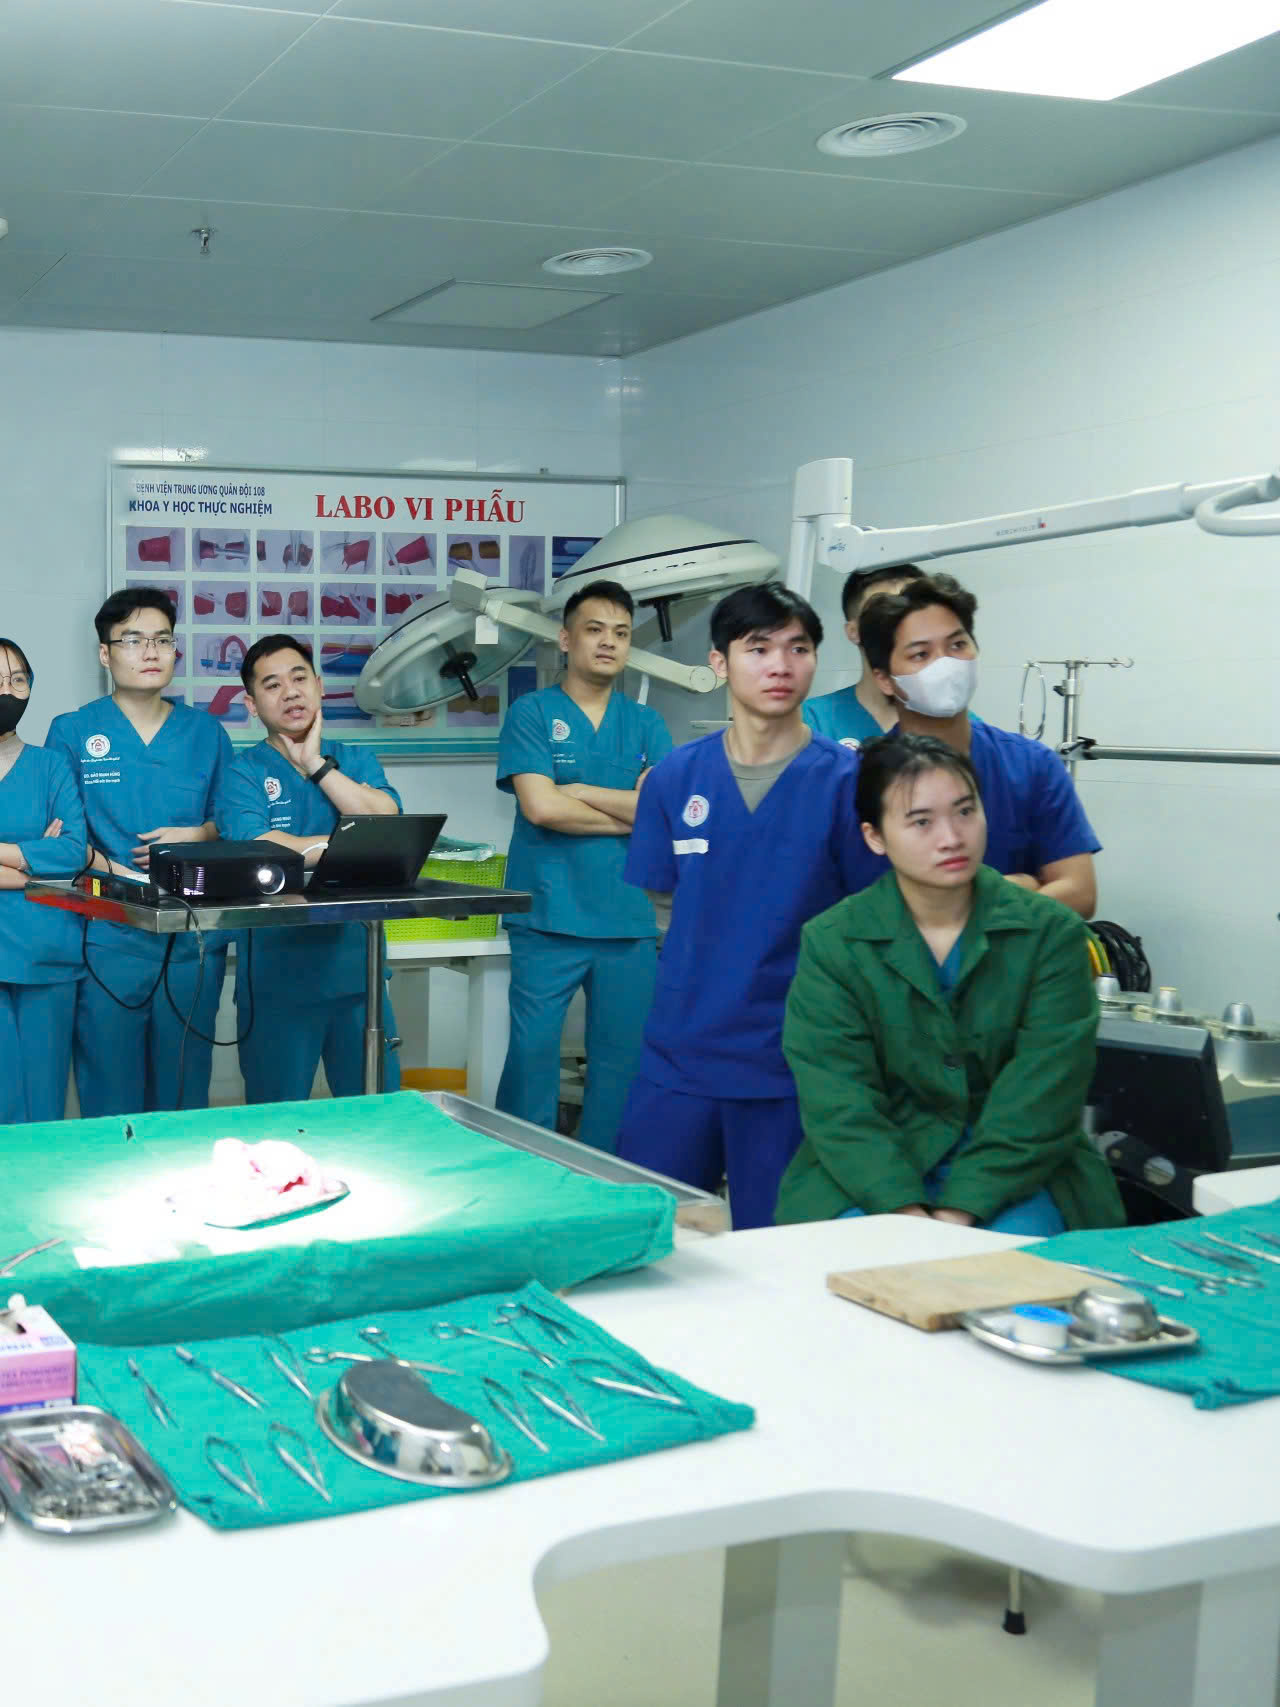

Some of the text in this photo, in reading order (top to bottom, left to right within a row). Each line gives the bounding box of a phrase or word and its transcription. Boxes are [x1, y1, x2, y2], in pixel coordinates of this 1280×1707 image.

[156, 481, 172, 496] VIỆN
[174, 484, 196, 495] TRUNG
[198, 483, 218, 495] ƯƠNG
[219, 483, 238, 497] QUÂN
[239, 483, 252, 498] ĐỘI
[253, 486, 265, 496] 108
[129, 499, 272, 517] KHOA Y HỌC THỰC NGHIỆM
[315, 488, 525, 523] LABO VI PHẪU
